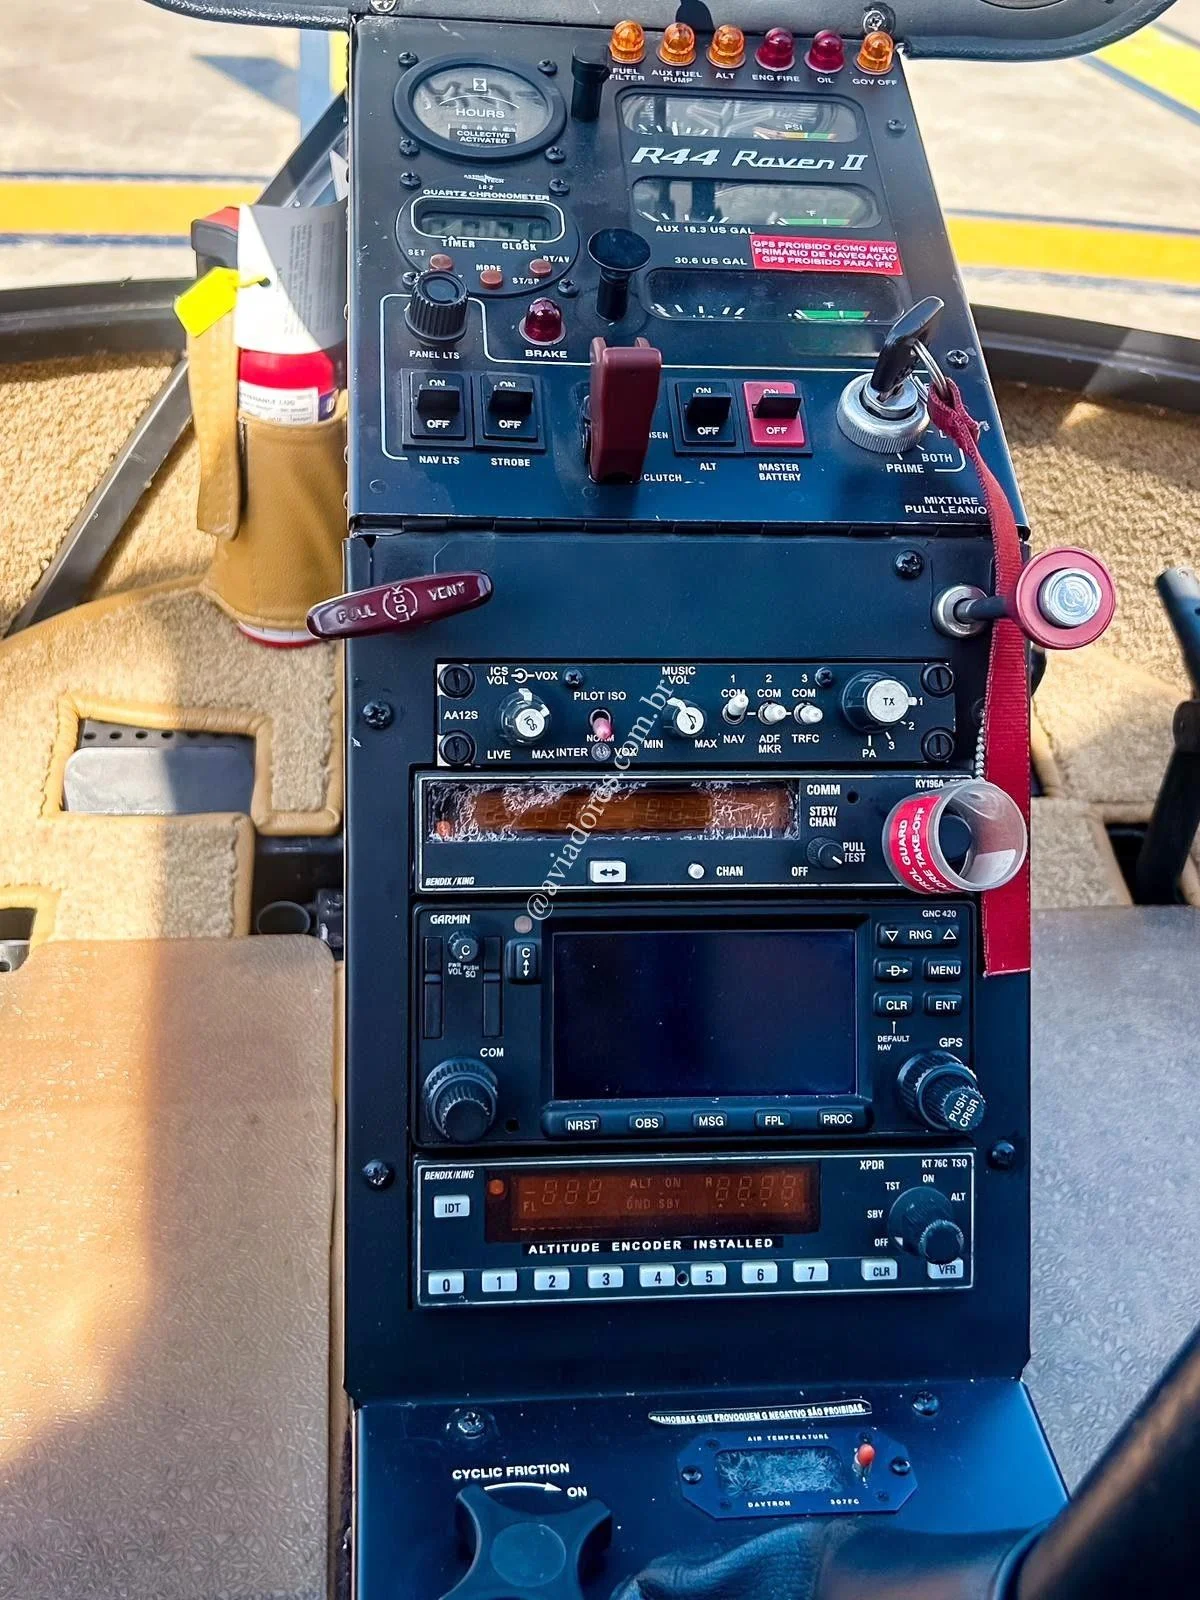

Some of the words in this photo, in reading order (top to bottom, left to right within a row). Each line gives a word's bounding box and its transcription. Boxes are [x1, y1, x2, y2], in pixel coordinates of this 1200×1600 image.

[612, 67, 640, 75] FUEL
[676, 70, 703, 78] FUEL
[663, 76, 693, 84] PUMP
[456, 108, 505, 118] HOURS
[456, 130, 510, 138] COLLECTIVE
[459, 136, 508, 144] ACTIVATED
[630, 147, 720, 166] R44
[732, 150, 834, 170] Raven
[840, 154, 868, 171] II
[422, 189, 468, 198] QUARTZ
[468, 191, 551, 201] CHRONOMETER
[655, 225, 680, 233] AUX
[683, 226, 707, 234] 18.3
[709, 226, 727, 234] US
[729, 227, 755, 235] GAL
[441, 239, 476, 249] TIMER
[501, 242, 537, 251] CLOCK
[752, 240, 776, 248] GPS
[778, 241, 832, 250] PROIBIDO
[833, 244, 867, 252] COMO
[869, 245, 897, 254] MEIO
[674, 256, 699, 264] 30.6
[701, 257, 719, 265] US
[810, 250, 826, 258] DE
[828, 250, 898, 262] NAVEGAÇÃO
[761, 255, 785, 264] GPS
[787, 257, 841, 266] PROIBIDO
[875, 260, 893, 269] IFR
[475, 264, 502, 272] MODE
[409, 350, 440, 359] PANEL
[442, 351, 460, 360] LTS
[525, 349, 568, 359] BRAKE
[426, 419, 450, 429] OFF
[498, 419, 522, 429] OFF
[697, 426, 720, 435] OFF
[766, 426, 788, 435] OFF
[419, 455, 439, 464] NAV
[441, 456, 460, 465] LTS
[490, 457, 531, 467] STROBE
[921, 453, 953, 463] BOTH
[699, 462, 717, 471] ALT
[758, 463, 800, 472] MASTER
[886, 463, 925, 474] PRIME
[643, 473, 682, 482] CLUTCH
[758, 472, 801, 481] BATTERY
[924, 496, 980, 505] MIXTURE
[905, 504, 939, 514] PULL
[941, 505, 987, 515] LEAN/O
[390, 584, 410, 623] LOCK
[490, 666, 509, 676] ICS
[534, 671, 559, 681] VOX
[661, 666, 696, 676] MUSIC
[486, 676, 509, 685] VOL
[667, 675, 690, 685] VOL
[765, 674, 773, 683] 2
[801, 674, 808, 683] 3
[573, 691, 605, 701] PILOT
[608, 691, 627, 701] ISO
[721, 688, 746, 698] COM
[756, 688, 782, 698] COM
[791, 688, 816, 698] COM
[882, 697, 896, 706] TX
[443, 710, 479, 720] AA12S
[908, 722, 915, 731] 2
[694, 739, 718, 748] MAX
[723, 734, 746, 744] NAV
[758, 734, 781, 743] ADF
[791, 734, 820, 743] TRFC
[643, 739, 664, 749] MIN
[758, 744, 782, 754] MKR
[888, 741, 895, 750] 3
[487, 750, 511, 760] LIVE
[531, 750, 555, 759] MAX
[556, 747, 589, 757] INTER
[862, 748, 877, 758] PA
[806, 784, 841, 795] COMM
[809, 806, 838, 816] STBY/
[809, 817, 837, 827] CHAN
[842, 841, 866, 852] PULL
[898, 819, 912, 866] GUARD
[844, 852, 866, 863] TEST
[716, 865, 744, 877] CHAN
[791, 866, 809, 877] OFF
[922, 910, 941, 918] GNC
[942, 910, 957, 918] 420
[430, 914, 471, 925] GARMIN
[909, 930, 933, 940] RNG
[447, 968, 463, 976] VOL
[930, 965, 961, 975] MENU
[886, 1000, 908, 1010] CLR
[935, 1000, 958, 1010] ENT
[877, 1035, 910, 1043] DEFAULT
[939, 1037, 963, 1048] GPS
[480, 1047, 504, 1058] COM
[948, 1093, 969, 1123] PUSH
[635, 1117, 659, 1129] OBS
[699, 1115, 724, 1127] MSG
[765, 1114, 785, 1126] FPL
[823, 1113, 853, 1125] PROC
[567, 1119, 597, 1131] NRST
[859, 1159, 885, 1171] XPDR
[921, 1159, 932, 1168] KT
[424, 1170, 475, 1180] BENDIX/KING
[922, 1174, 935, 1183] ON
[885, 1181, 901, 1191] TST
[950, 1192, 966, 1202] ALT
[444, 1202, 461, 1214] IDT
[867, 1209, 884, 1219] SBY
[528, 1242, 600, 1255] ALTITUDE
[611, 1240, 682, 1252] ENCODER
[693, 1238, 774, 1250] INSTALLED
[874, 1238, 889, 1247] OFF
[705, 1270, 713, 1283] 5
[756, 1268, 764, 1282] 6
[807, 1266, 815, 1280] 7
[873, 1266, 890, 1277] CLR
[548, 1274, 556, 1289] 2
[602, 1272, 610, 1286] 3
[654, 1271, 662, 1284] 4
[442, 1278, 450, 1293] 0
[496, 1276, 502, 1290] 1
[696, 1414, 713, 1423] QUE
[714, 1411, 760, 1422] PROVOQUEM
[769, 1408, 806, 1420] NEGATIVO
[767, 1433, 829, 1441] TEMPERATURE
[452, 1467, 503, 1480] CYCLIC
[506, 1463, 570, 1477] FRICTION
[567, 1486, 588, 1498] ON
